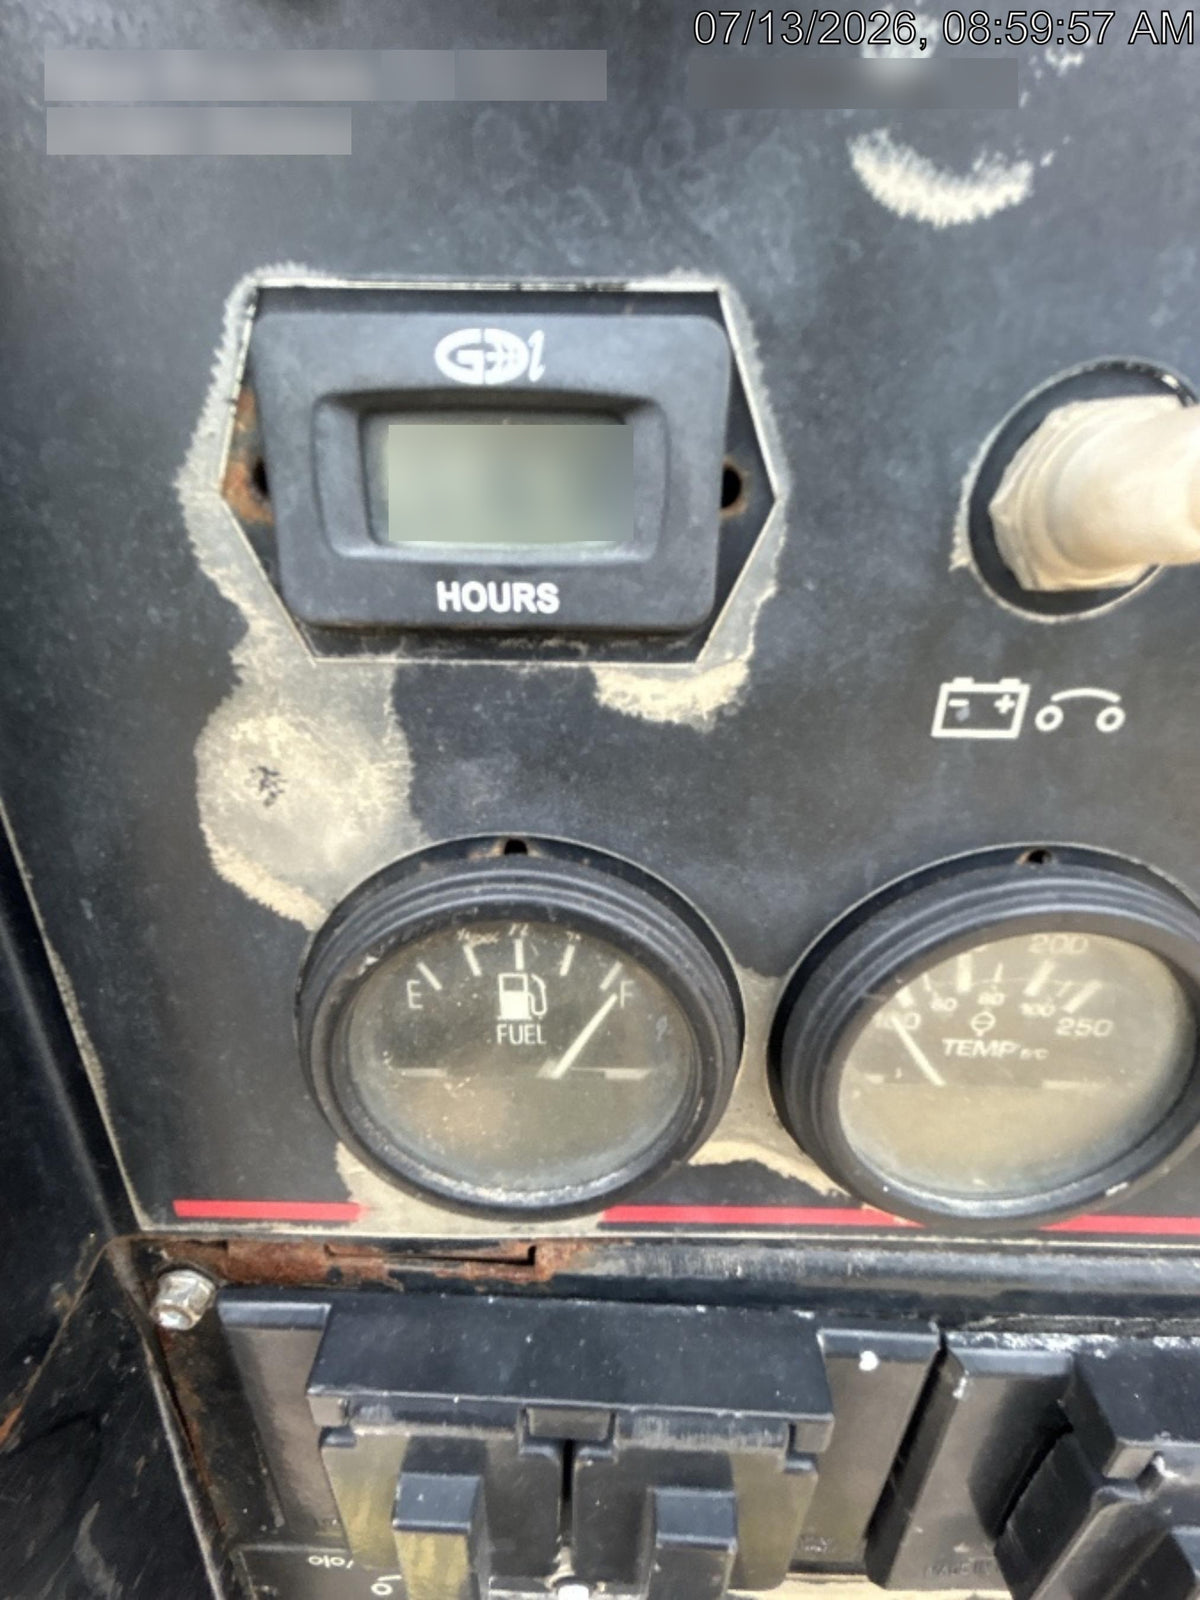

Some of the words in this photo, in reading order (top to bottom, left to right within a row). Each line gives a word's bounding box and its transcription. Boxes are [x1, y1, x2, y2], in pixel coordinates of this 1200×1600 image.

[436, 580, 560, 614] HOURS
[1028, 934, 1089, 954] 200
[406, 980, 423, 1010] E
[620, 981, 634, 1009] F
[496, 1023, 547, 1046] FUEL
[1055, 1017, 1114, 1037] 250
[942, 1037, 1020, 1058] TEMP
